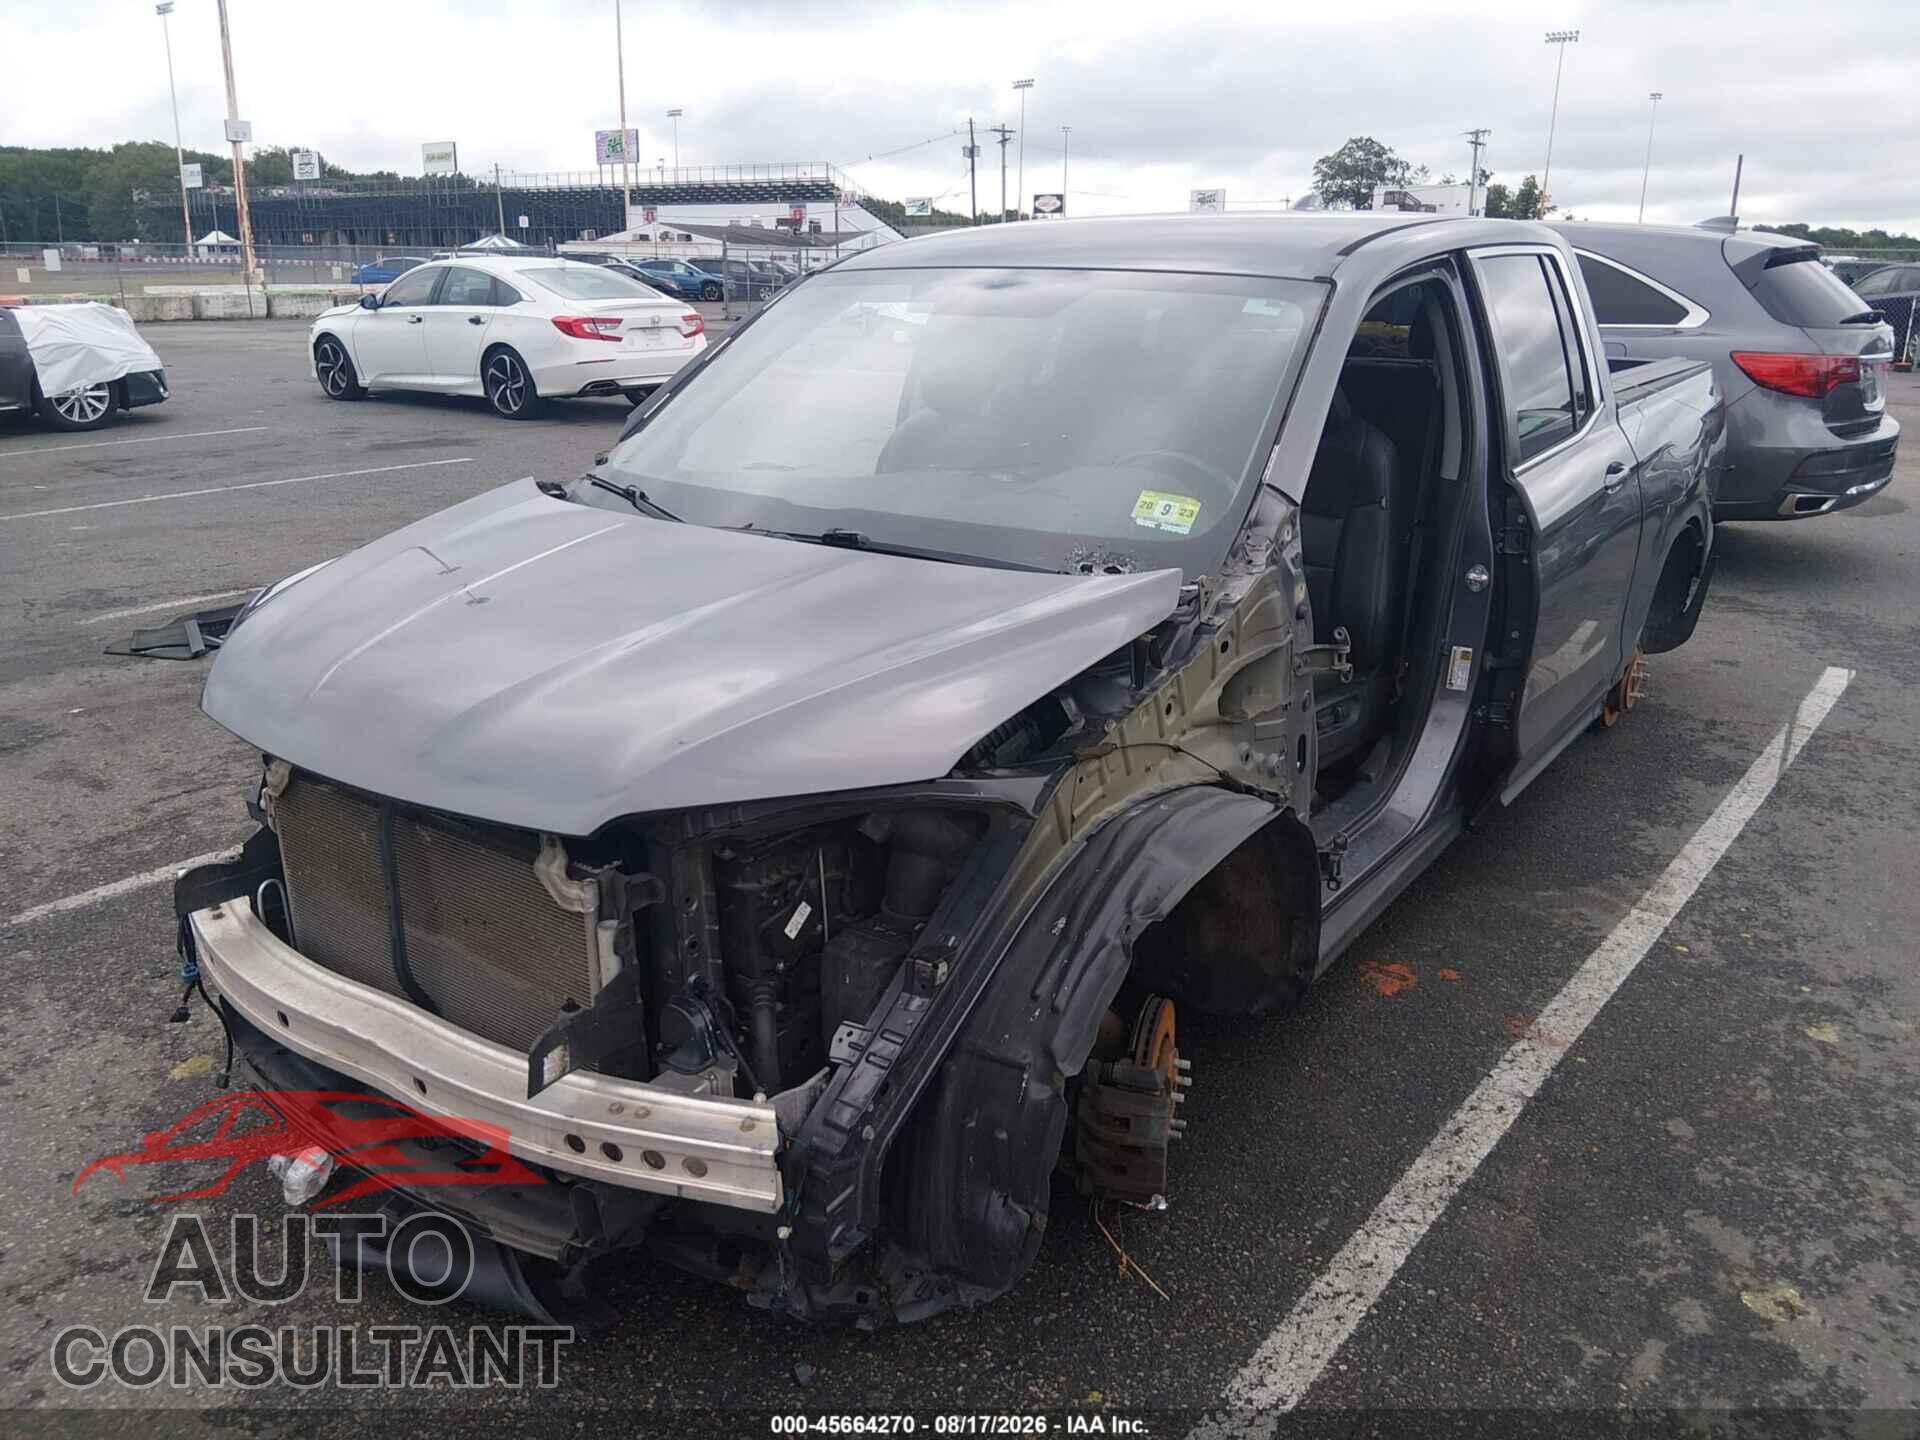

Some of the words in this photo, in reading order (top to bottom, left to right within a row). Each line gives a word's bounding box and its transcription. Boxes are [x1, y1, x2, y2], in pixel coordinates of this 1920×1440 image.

[1139, 500, 1154, 510] 20
[1161, 503, 1172, 516] 9
[1178, 508, 1194, 518] 23
